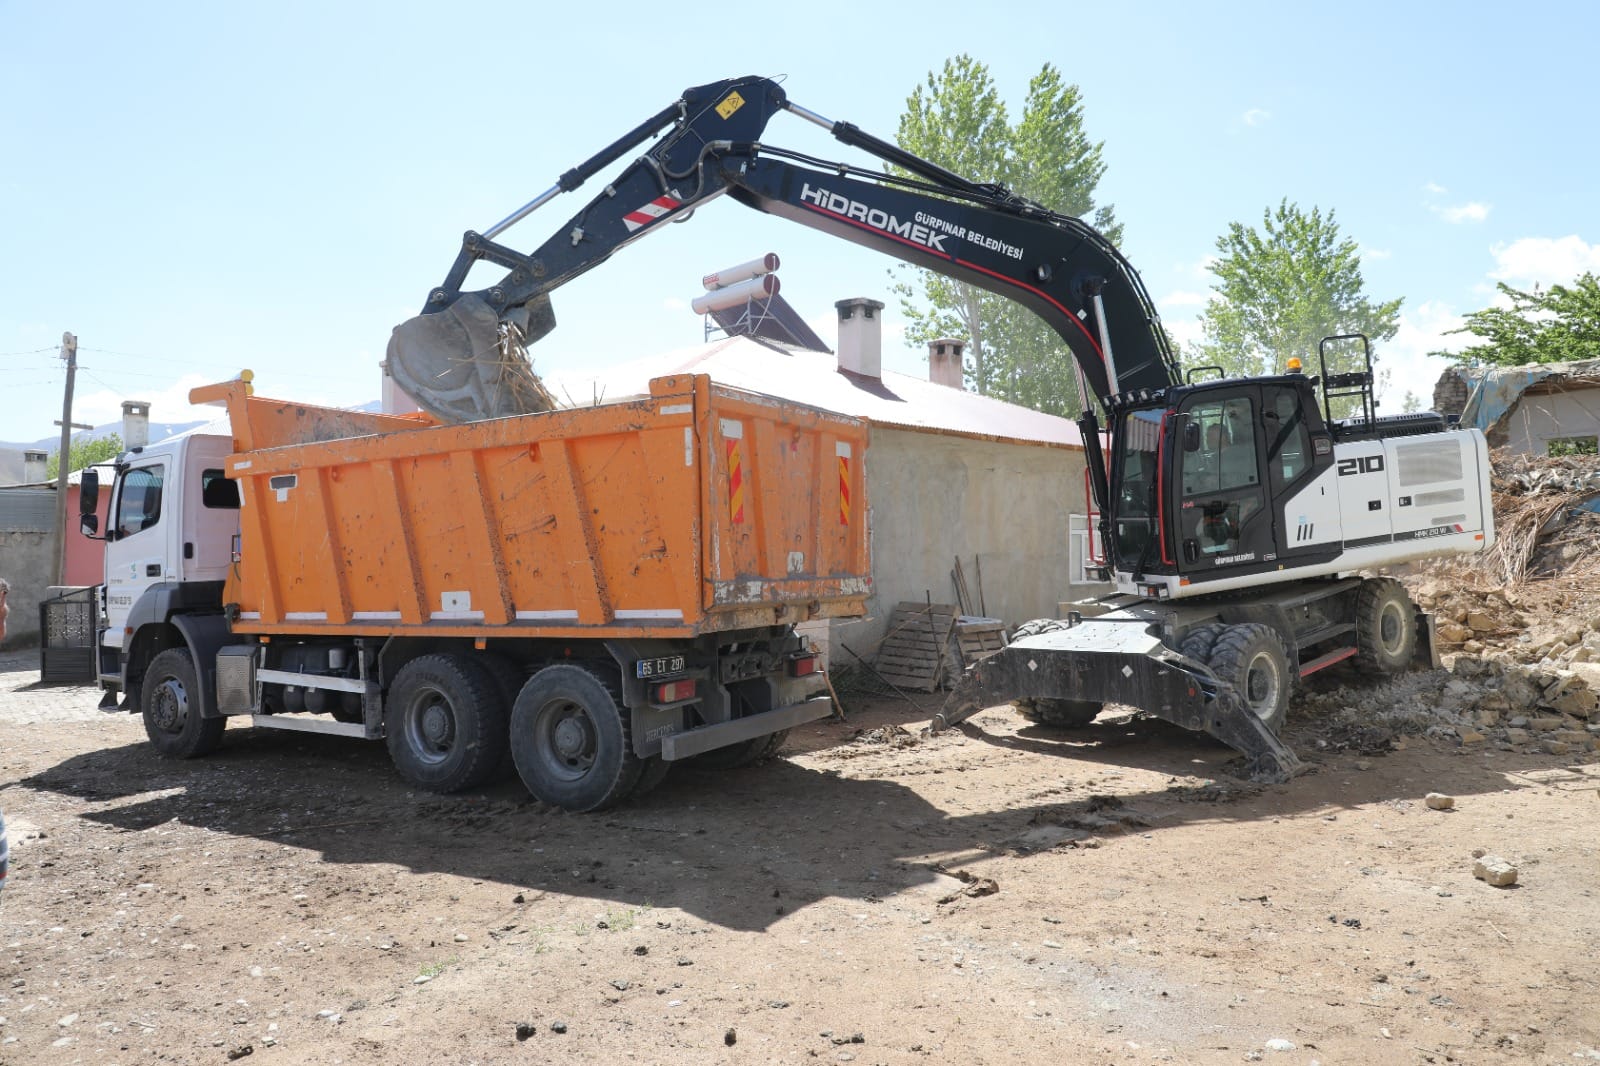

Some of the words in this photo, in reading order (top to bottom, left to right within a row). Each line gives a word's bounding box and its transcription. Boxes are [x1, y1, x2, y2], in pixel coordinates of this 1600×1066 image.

[914, 211, 966, 239] GÜRPINAR
[967, 230, 1024, 260] BELEDİYESİ
[1337, 455, 1385, 477] 210
[642, 662, 652, 675] 65
[657, 660, 666, 673] ET
[671, 657, 683, 671] 297
